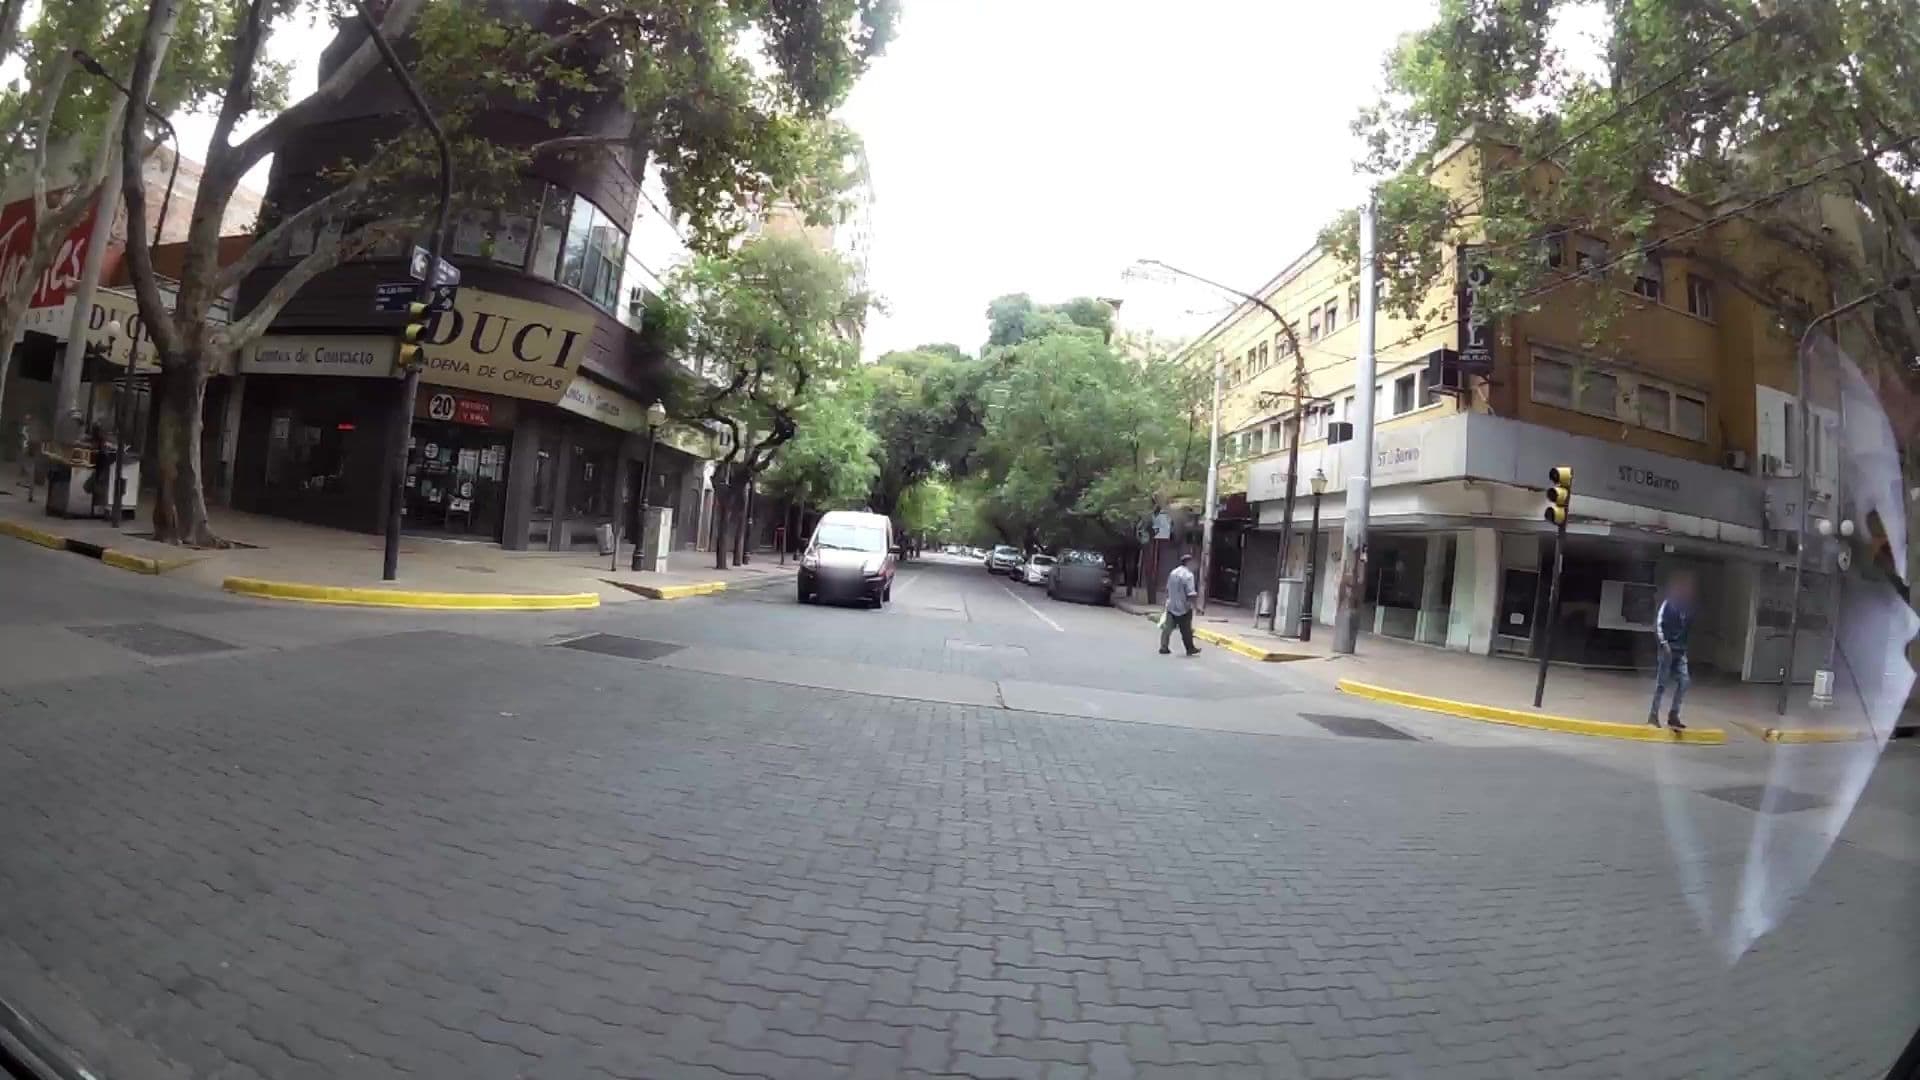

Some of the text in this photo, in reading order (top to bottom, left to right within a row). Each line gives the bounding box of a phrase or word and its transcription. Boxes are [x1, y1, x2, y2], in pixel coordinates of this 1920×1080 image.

[424, 308, 583, 369] DUCI
[424, 357, 470, 374] ADENA
[433, 396, 452, 415] 20
